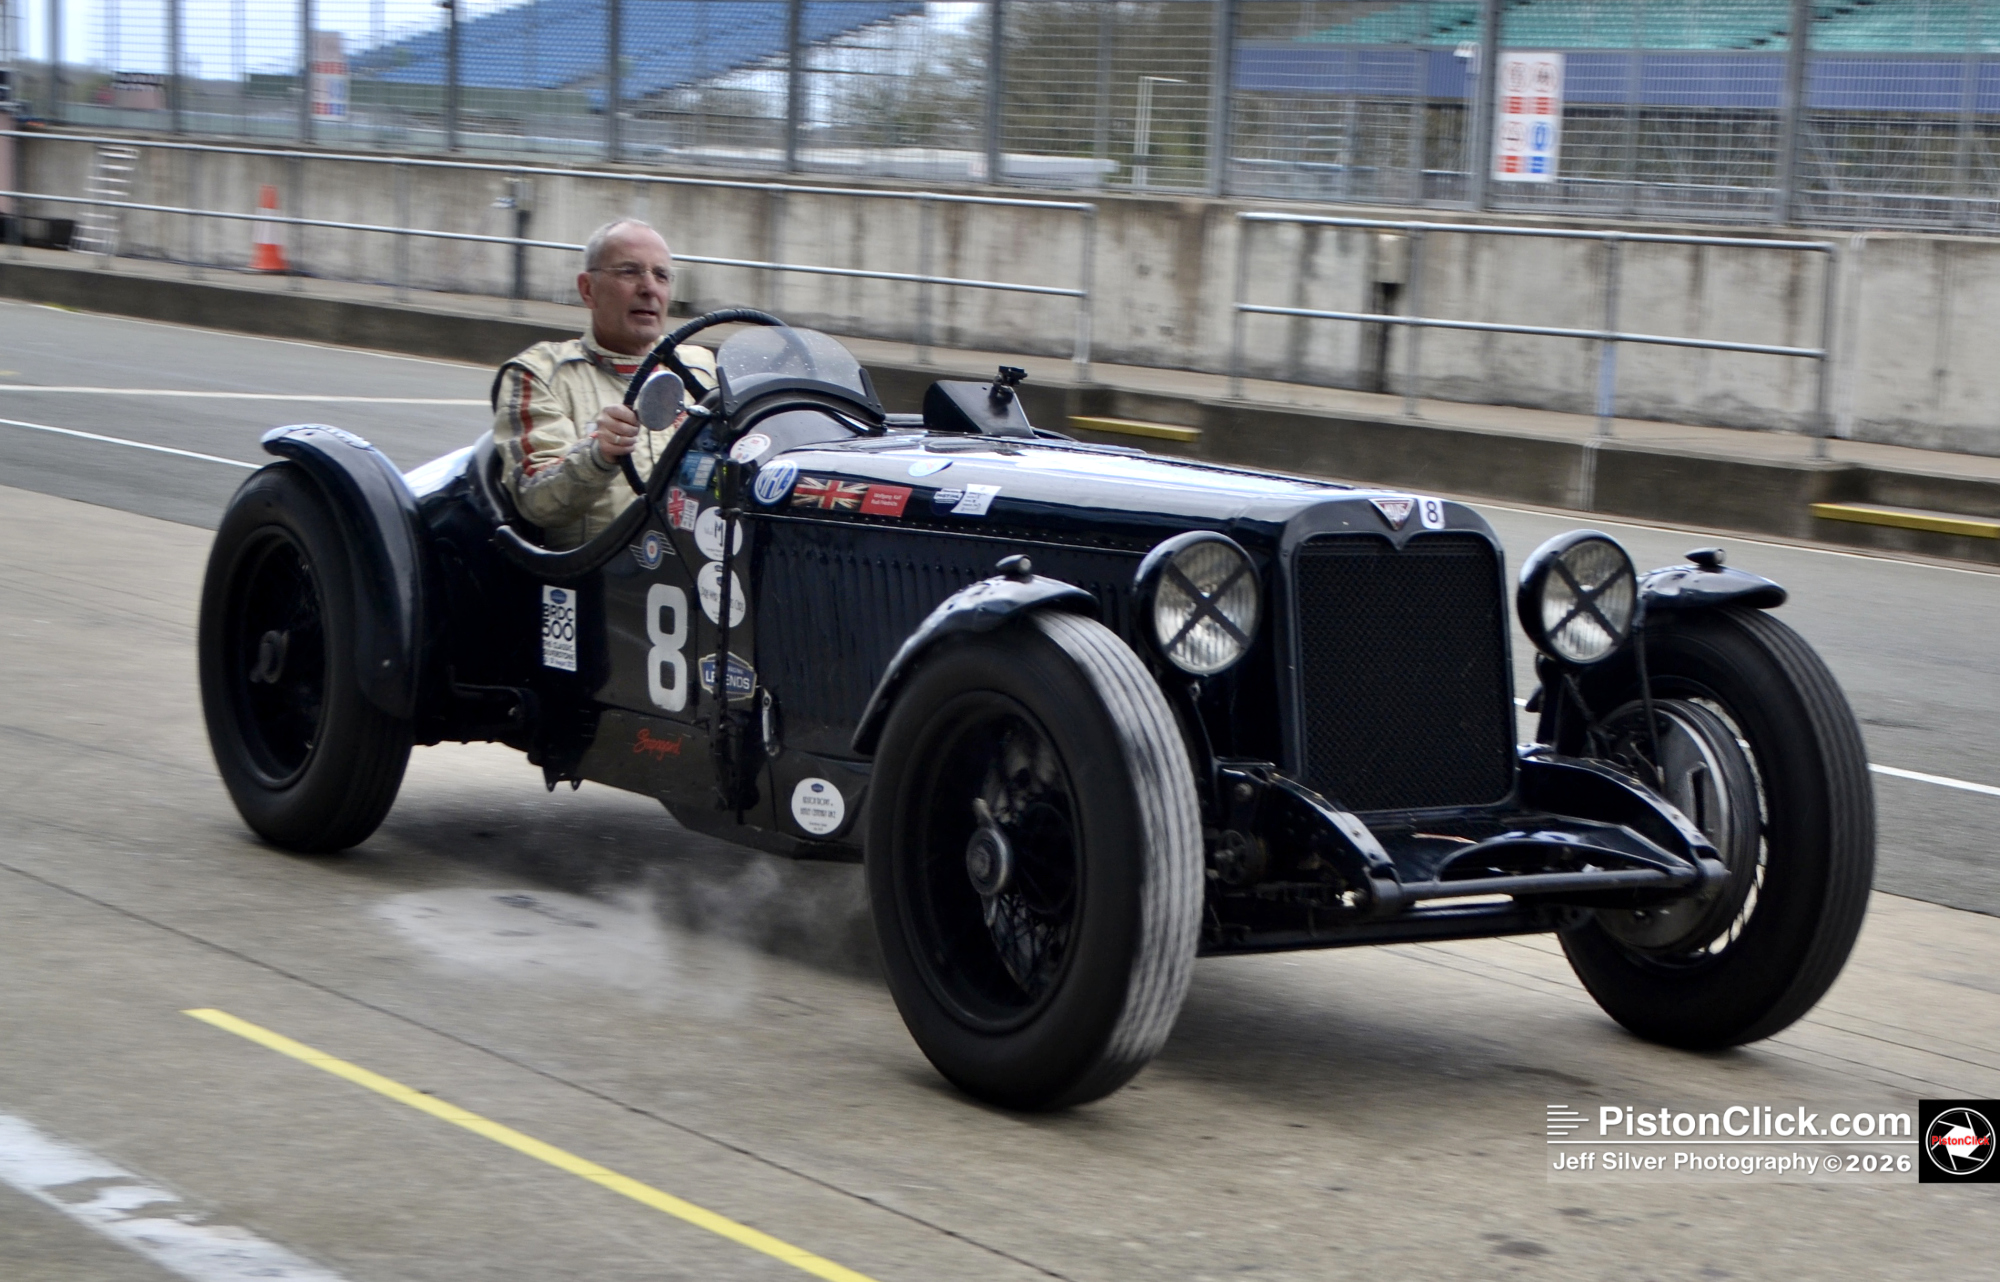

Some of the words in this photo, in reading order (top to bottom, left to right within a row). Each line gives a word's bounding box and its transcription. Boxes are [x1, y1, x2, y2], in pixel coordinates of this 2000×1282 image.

[1426, 500, 1438, 523] 8
[543, 603, 574, 622] BRDC
[543, 618, 575, 642] 500
[647, 583, 688, 713] 8
[705, 670, 750, 690] LEENDS
